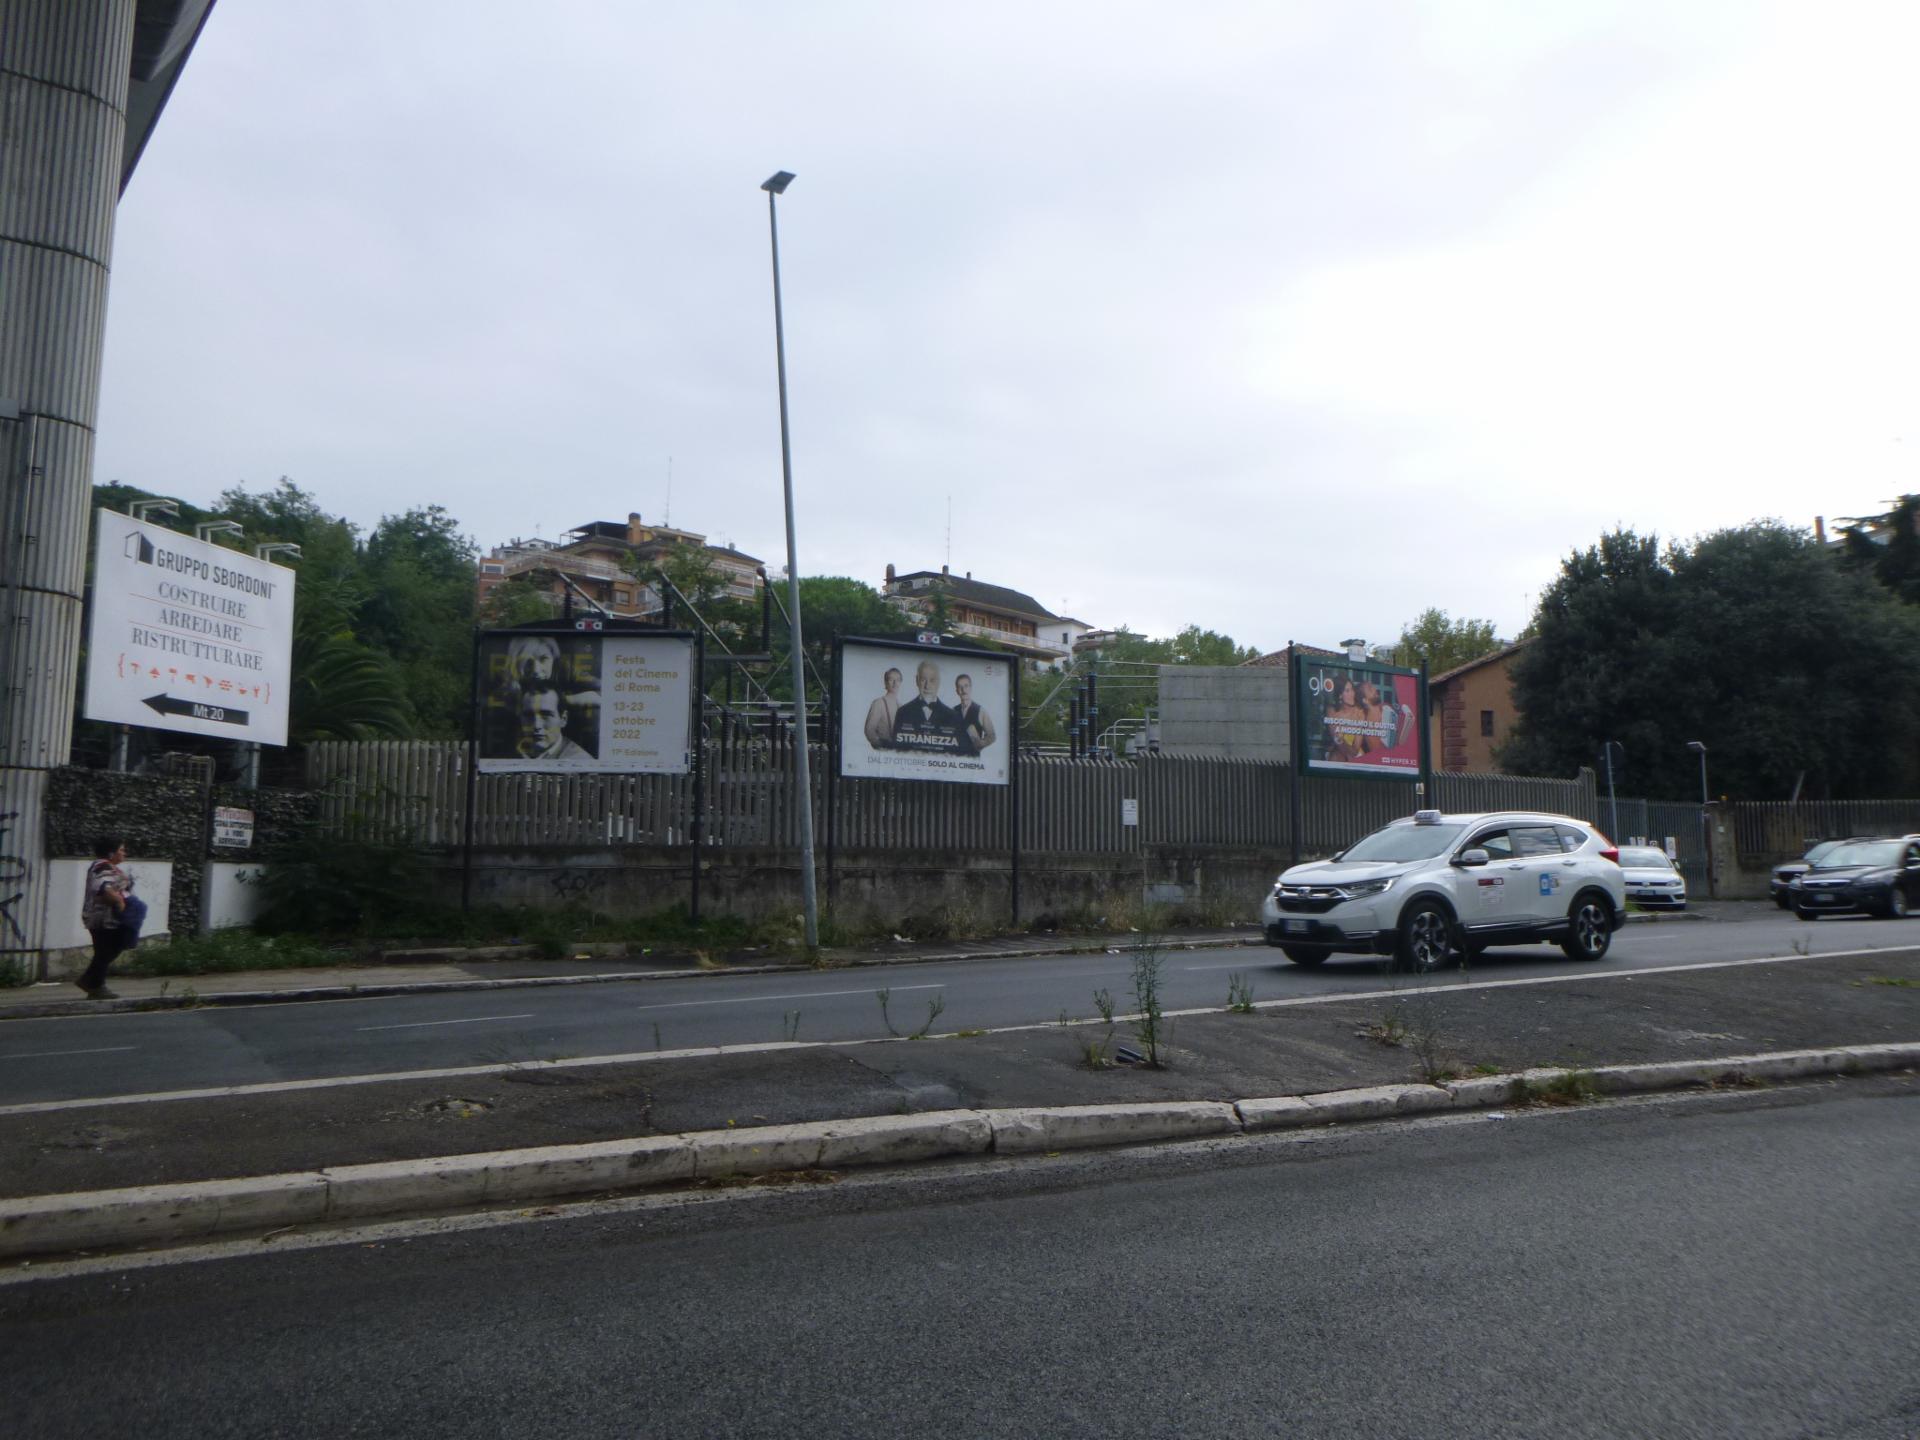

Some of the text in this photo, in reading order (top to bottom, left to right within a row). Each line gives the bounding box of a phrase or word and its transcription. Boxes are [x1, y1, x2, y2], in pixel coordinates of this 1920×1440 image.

[157, 549, 273, 600] GRUPPO SBORDONI
[158, 581, 246, 619] COSTRUIRE
[159, 608, 242, 642] ARREDARE
[132, 627, 263, 671] RISTRUTTURARE
[615, 655, 645, 665] Festa
[635, 669, 678, 679] Cinema
[614, 683, 661, 693] di Roma
[1309, 669, 1334, 696] glo
[211, 707, 224, 721] 20
[612, 716, 656, 726] ottobre
[613, 730, 640, 739] 2022
[896, 733, 959, 747] STRANEZZA
[928, 760, 947, 768] SOLO
[948, 761, 958, 769] AL
[959, 762, 985, 770] CINEMA
